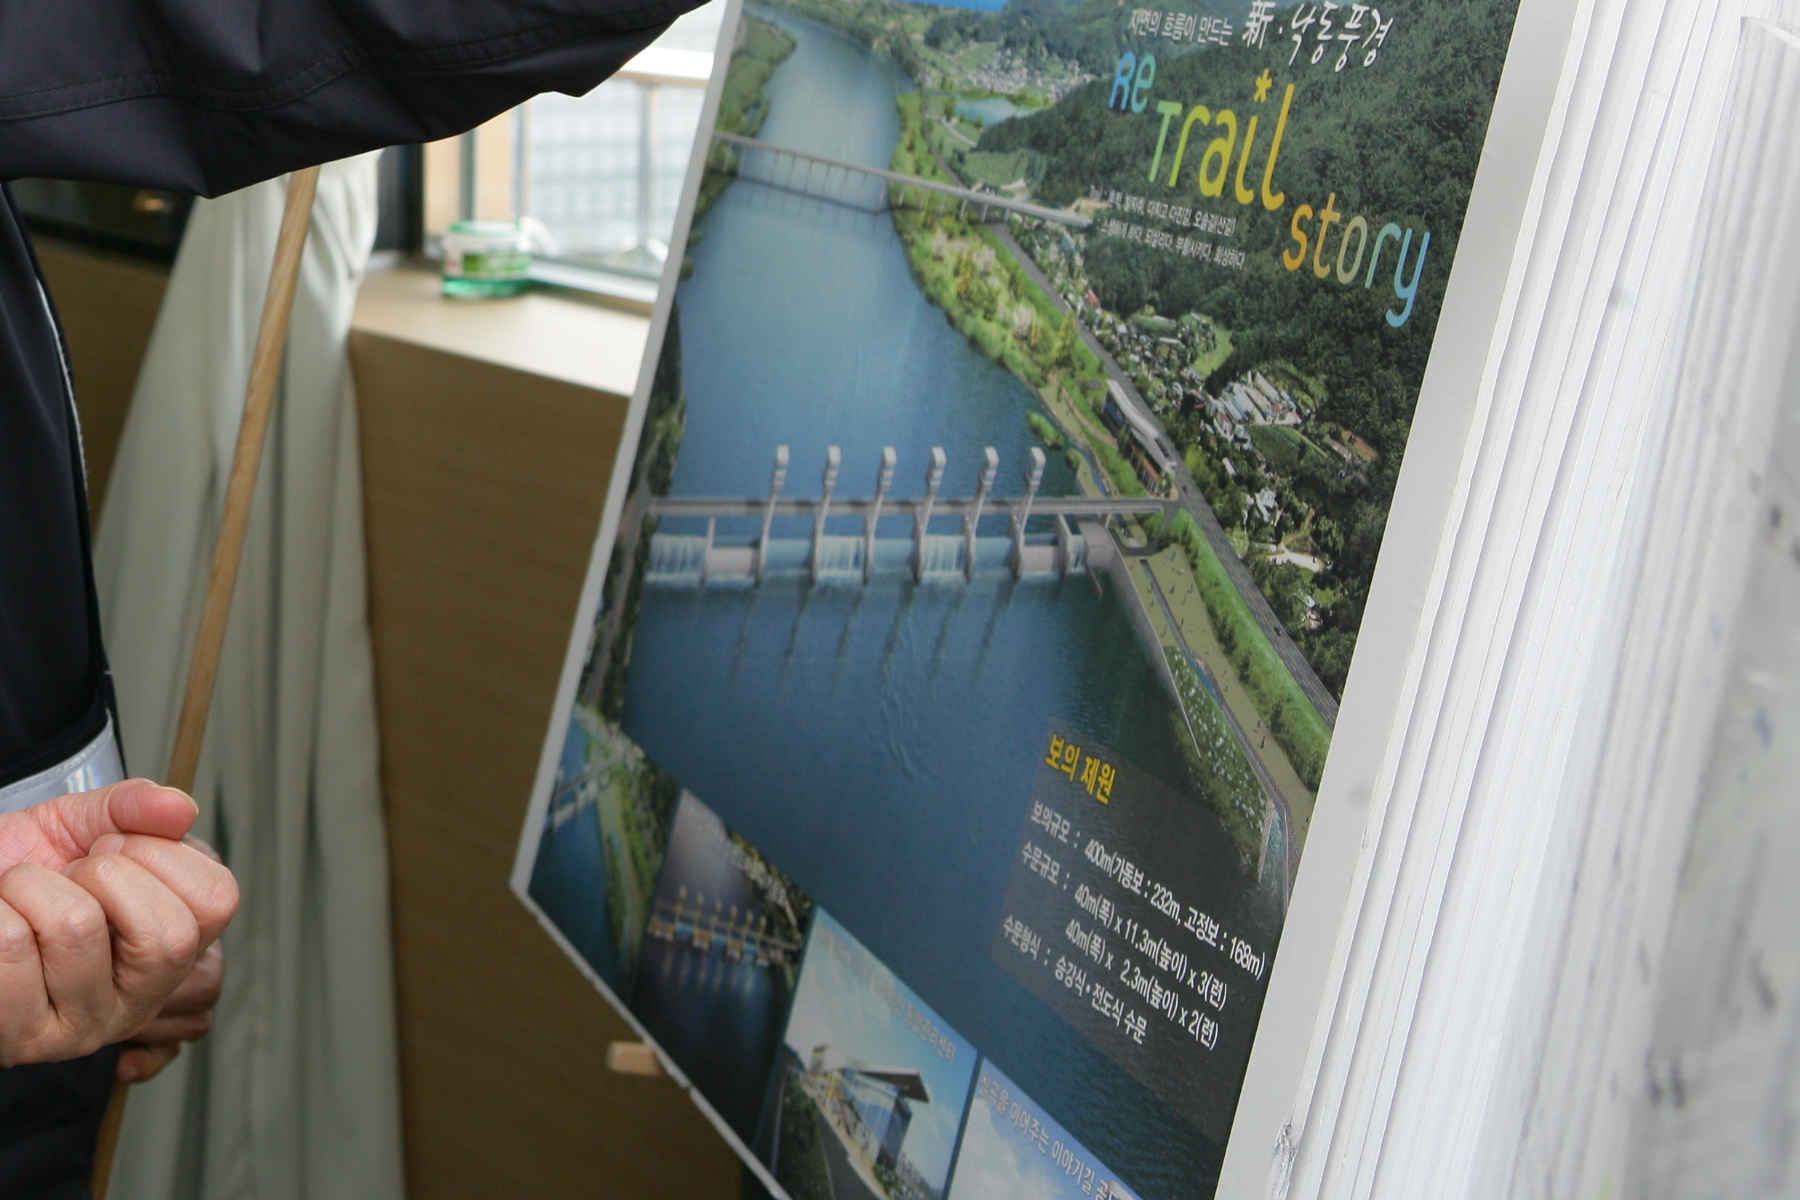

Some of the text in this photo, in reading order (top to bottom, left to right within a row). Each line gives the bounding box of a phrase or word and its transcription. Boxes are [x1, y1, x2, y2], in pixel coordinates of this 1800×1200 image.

[1128, 9, 1162, 37] 자연의
[1161, 12, 1197, 41] 흐름이
[1197, 15, 1234, 46] 만드는
[1149, 68, 1295, 211] Trail
[1283, 192, 1431, 328] story
[1045, 733, 1117, 805] 보의 제원
[1022, 841, 1061, 884] 수문규모
[1074, 883, 1115, 929] 40m(폭)
[1197, 971, 1228, 1011] 3(련)
[1030, 800, 1071, 843] 보의규모
[1150, 883, 1182, 925] 232m,
[1183, 906, 1220, 947] 고정보
[1229, 936, 1266, 980] 168m)
[1003, 914, 1042, 960] 수문형식
[1124, 1009, 1148, 1045] 수문
[1065, 918, 1106, 965] 40m(폭)
[1188, 1009, 1219, 1050] 2(련)
[1010, 1102, 1050, 1154] 이어주는
[1051, 1140, 1096, 1195] 이야기길
